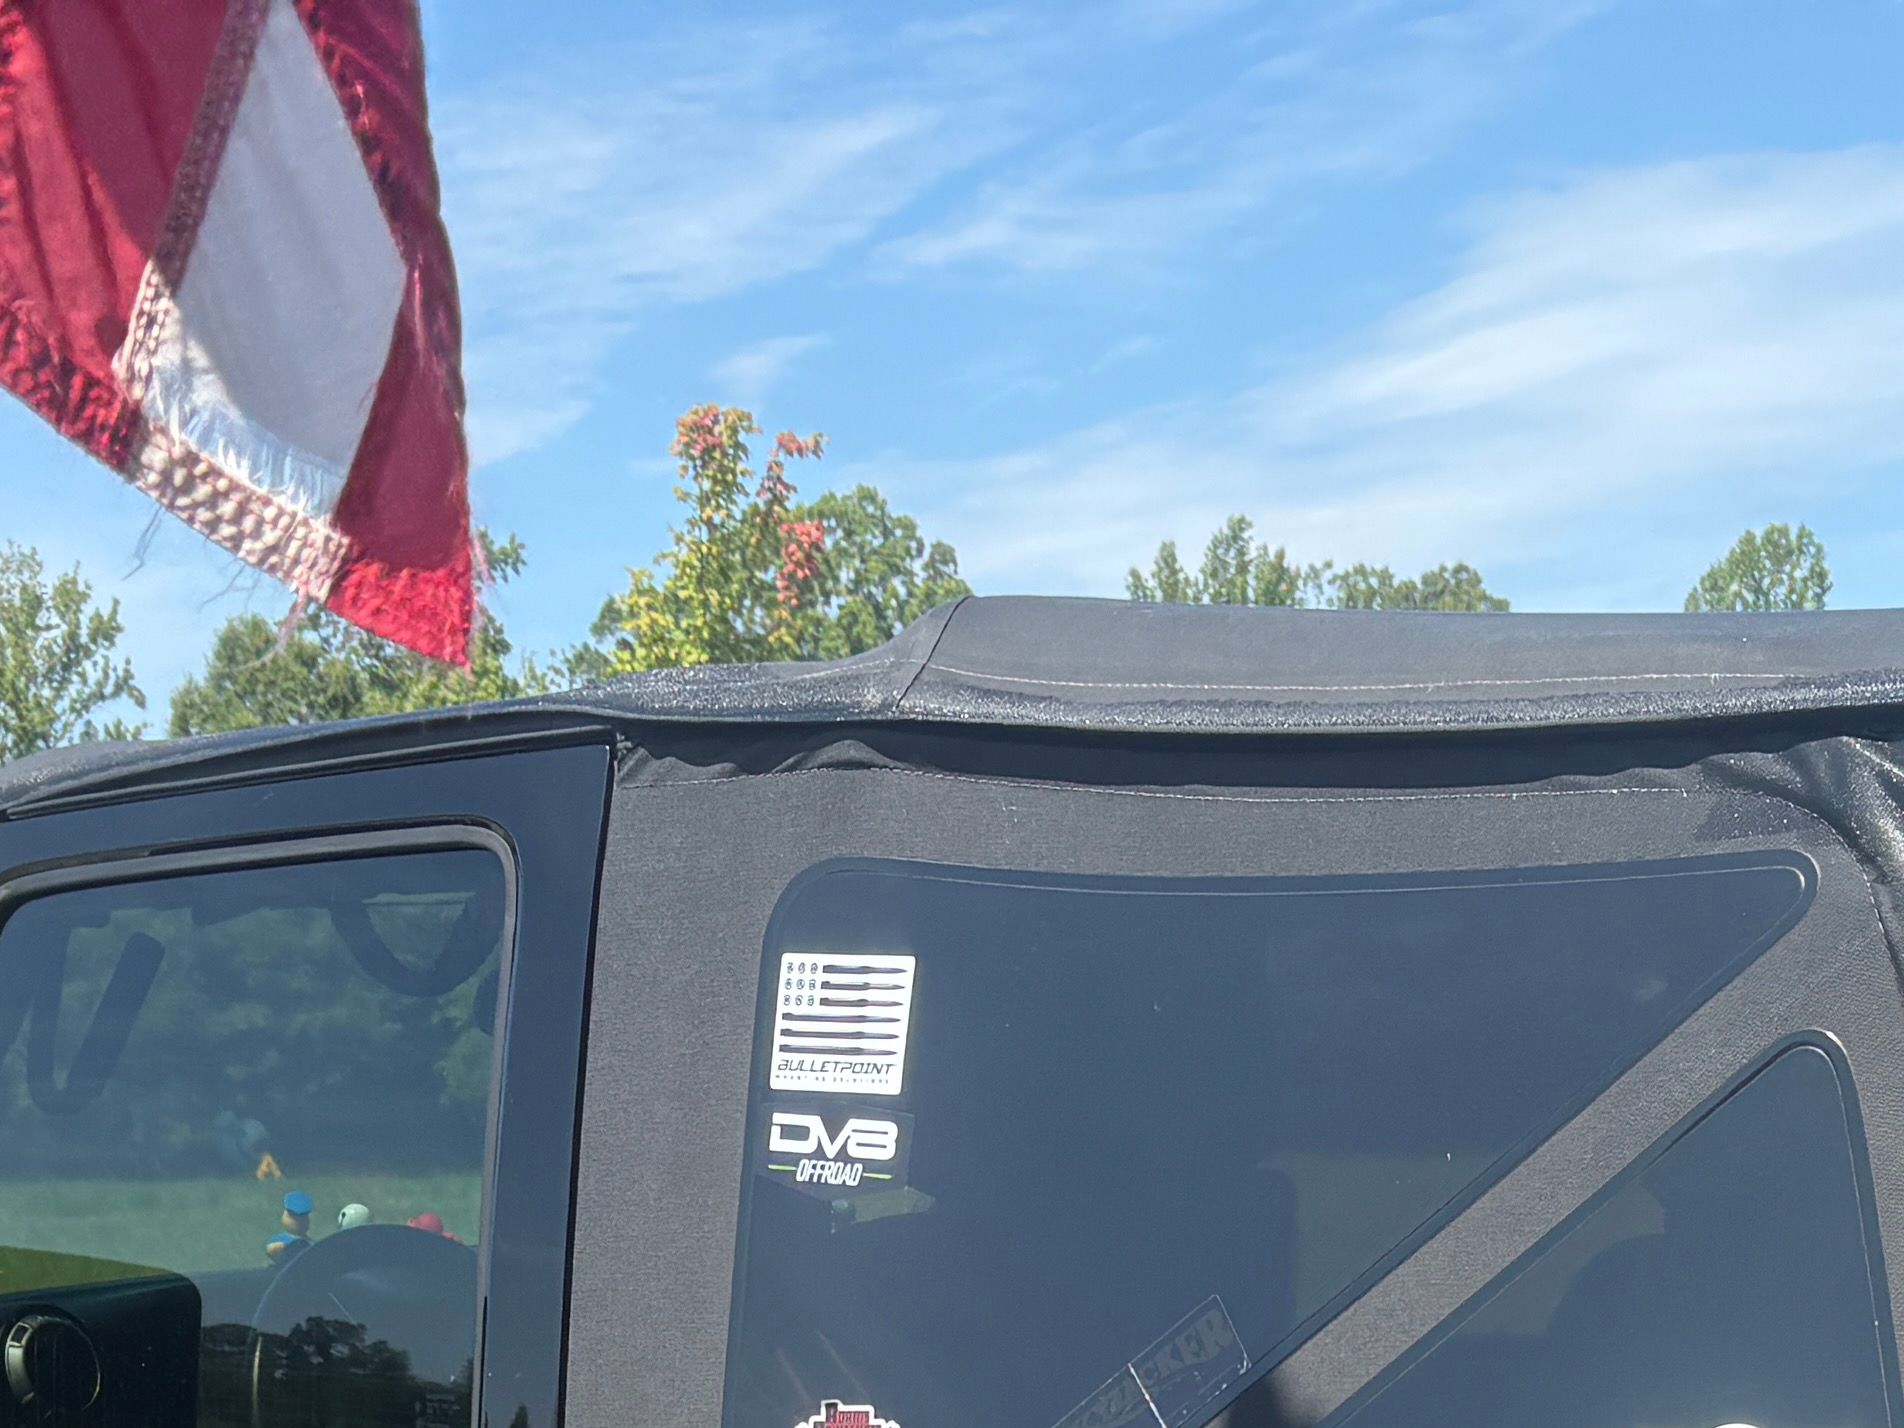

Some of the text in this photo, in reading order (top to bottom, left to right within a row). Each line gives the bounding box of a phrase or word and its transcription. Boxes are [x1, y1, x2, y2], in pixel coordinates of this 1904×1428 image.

[777, 1059, 896, 1075] BULLETPOINT
[769, 1112, 898, 1160] DV8
[796, 1159, 863, 1186] OFFROAD
